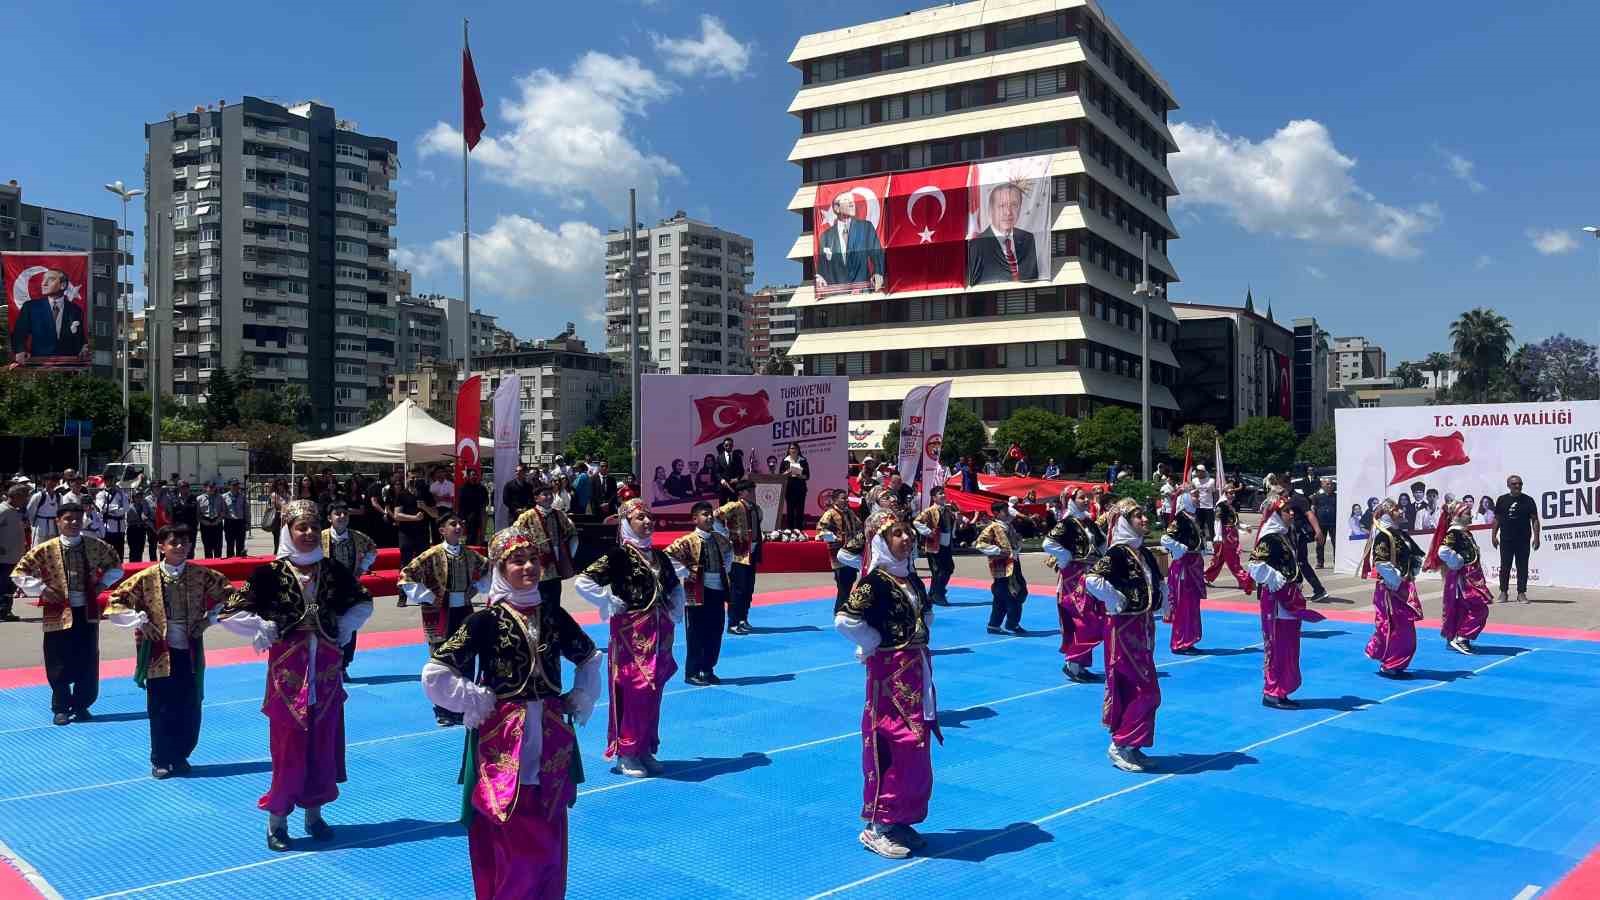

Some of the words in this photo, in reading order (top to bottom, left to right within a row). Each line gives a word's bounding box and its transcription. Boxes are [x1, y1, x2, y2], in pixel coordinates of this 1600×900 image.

[786, 396, 825, 418] GÜCÜ
[1434, 415, 1457, 427] T.C.
[1462, 414, 1509, 426] ADANA
[1514, 408, 1572, 425] VALİLİĞİ
[1553, 431, 1600, 455] TÜRKİ
[1544, 534, 1552, 542] 19
[1553, 532, 1573, 541] MAYIS
[1554, 542, 1571, 551] SPOR
